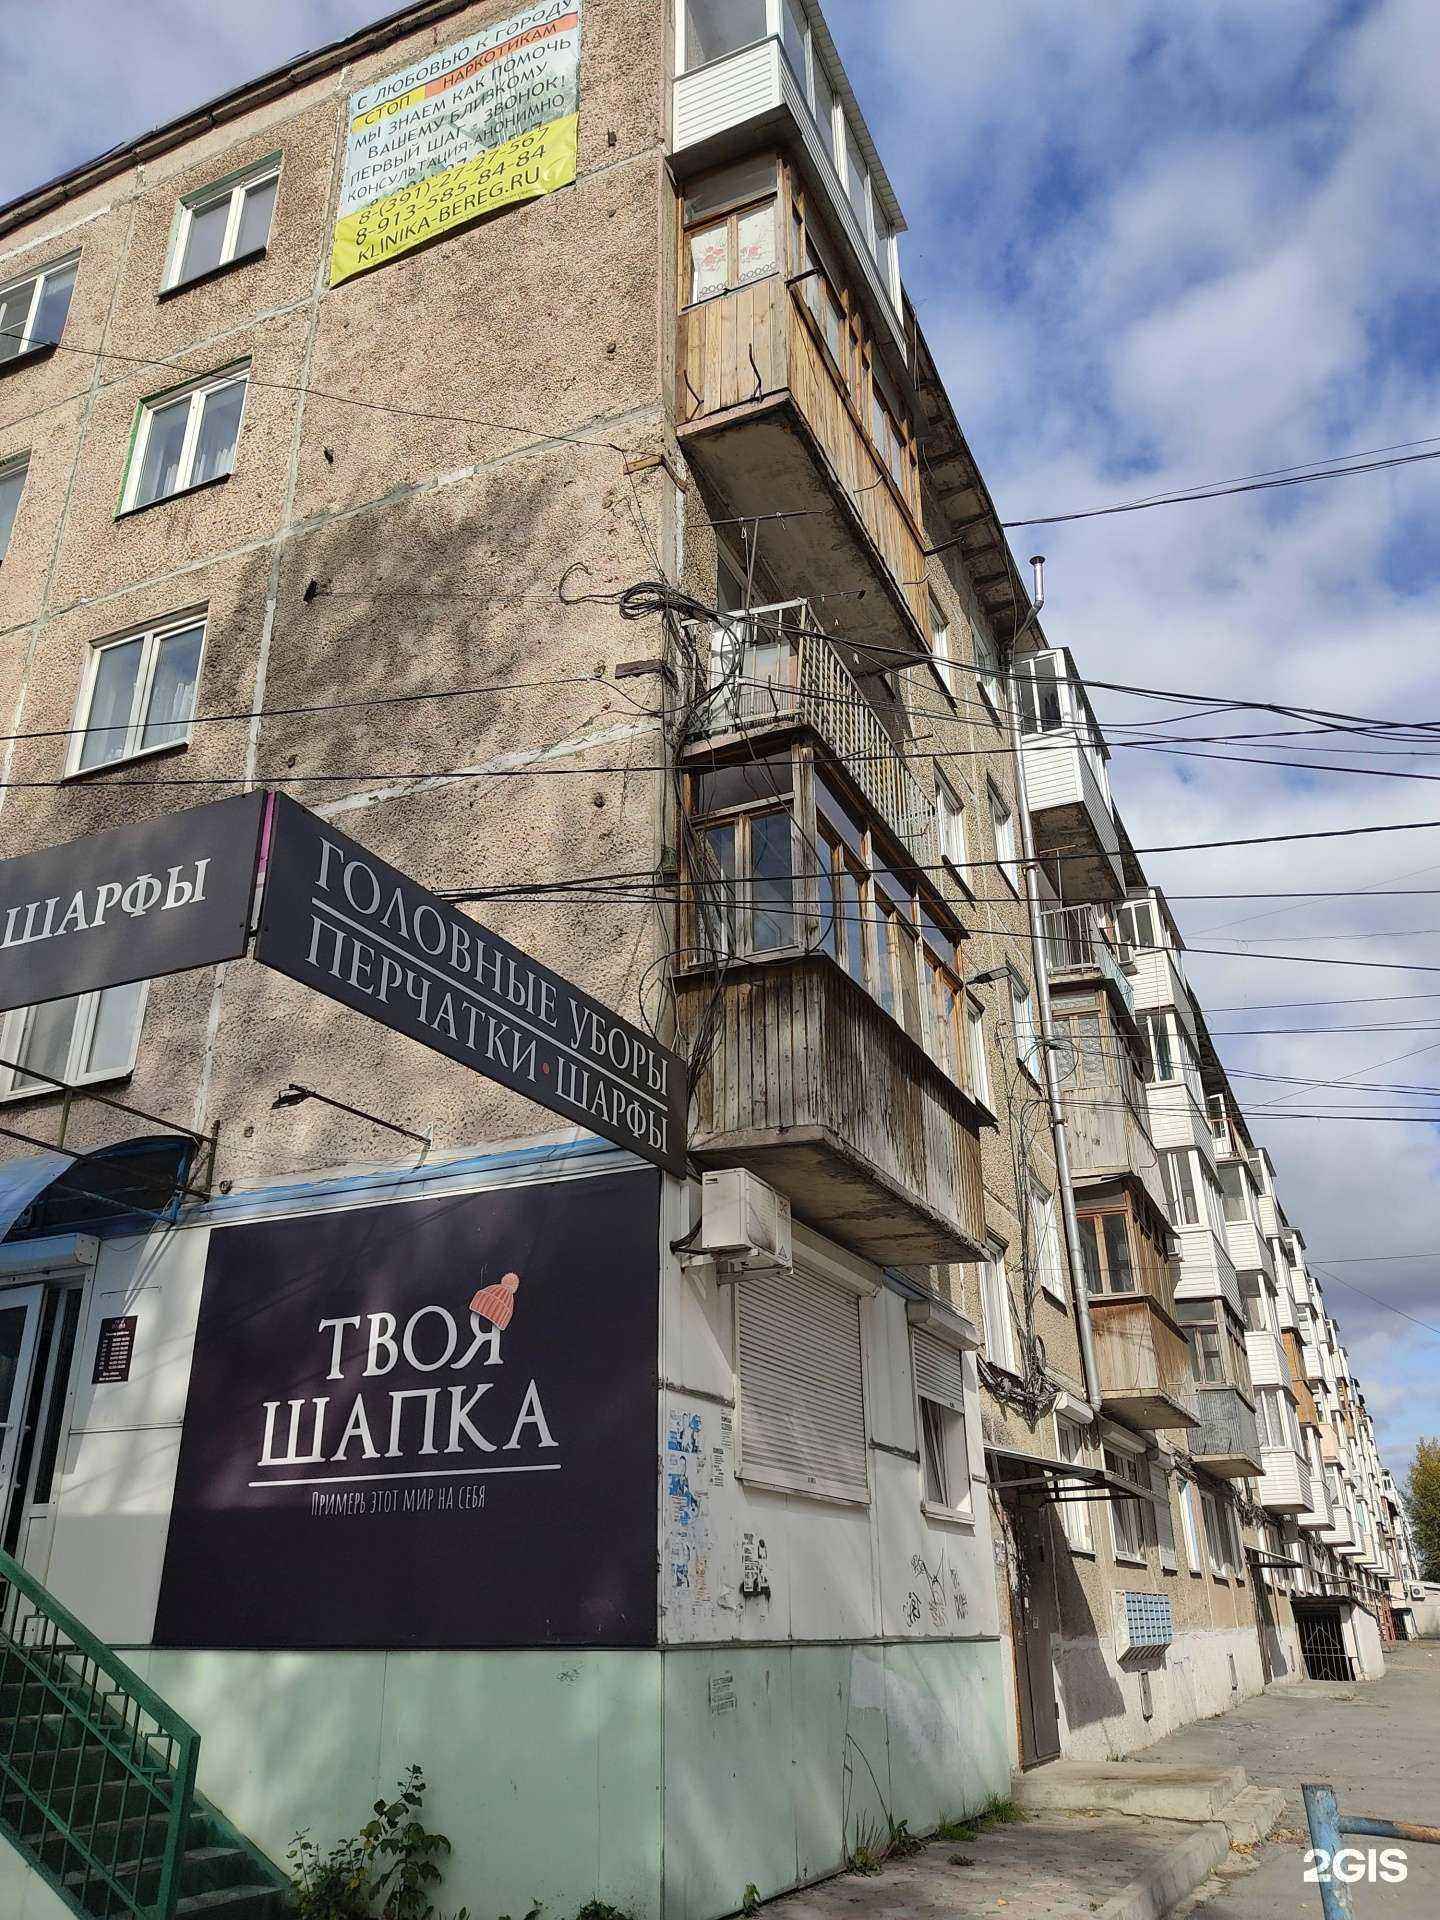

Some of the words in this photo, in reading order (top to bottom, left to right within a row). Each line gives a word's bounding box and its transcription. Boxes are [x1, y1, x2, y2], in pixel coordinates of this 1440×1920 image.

[353, 126, 381, 151] МЫ
[388, 98, 446, 133] ЗНАЕМ
[452, 77, 485, 105] КАК
[491, 38, 571, 81] ПОМОЧЬ
[358, 96, 368, 111] С
[375, 46, 470, 102] ЛЮБОВЬЮ
[476, 36, 490, 52] К
[496, 0, 573, 42] ГОРОДУ
[365, 95, 411, 124] СТОП
[443, 23, 558, 89] НАРКОТИКАМ
[350, 146, 420, 189] ПЕРВЫЙ
[428, 125, 466, 153] ШАГ
[484, 75, 566, 124] ЗВОНОК!
[368, 115, 445, 159] ВАШЕМУ
[451, 62, 549, 122] БЛИЗКОМУ
[355, 144, 547, 246] 8-913-585-84-84
[357, 167, 541, 264] KLINIKA-BEREG.RU
[0, 857, 212, 950] ШАРФЫ
[314, 836, 560, 1027] ГОЛОВНЫЕ
[568, 996, 669, 1098] УБОРЫ
[305, 914, 539, 1083] ПЕРЧАТКИ
[555, 1055, 669, 1156] ШАРФЫ
[318, 1305, 505, 1380] ТВОЯ
[257, 1378, 559, 1467] ШАПКА
[369, 1489, 399, 1514] ЭТОТ
[403, 1487, 434, 1513] МИР
[438, 1486, 453, 1510] НА
[458, 1485, 486, 1510] СЕБЯ
